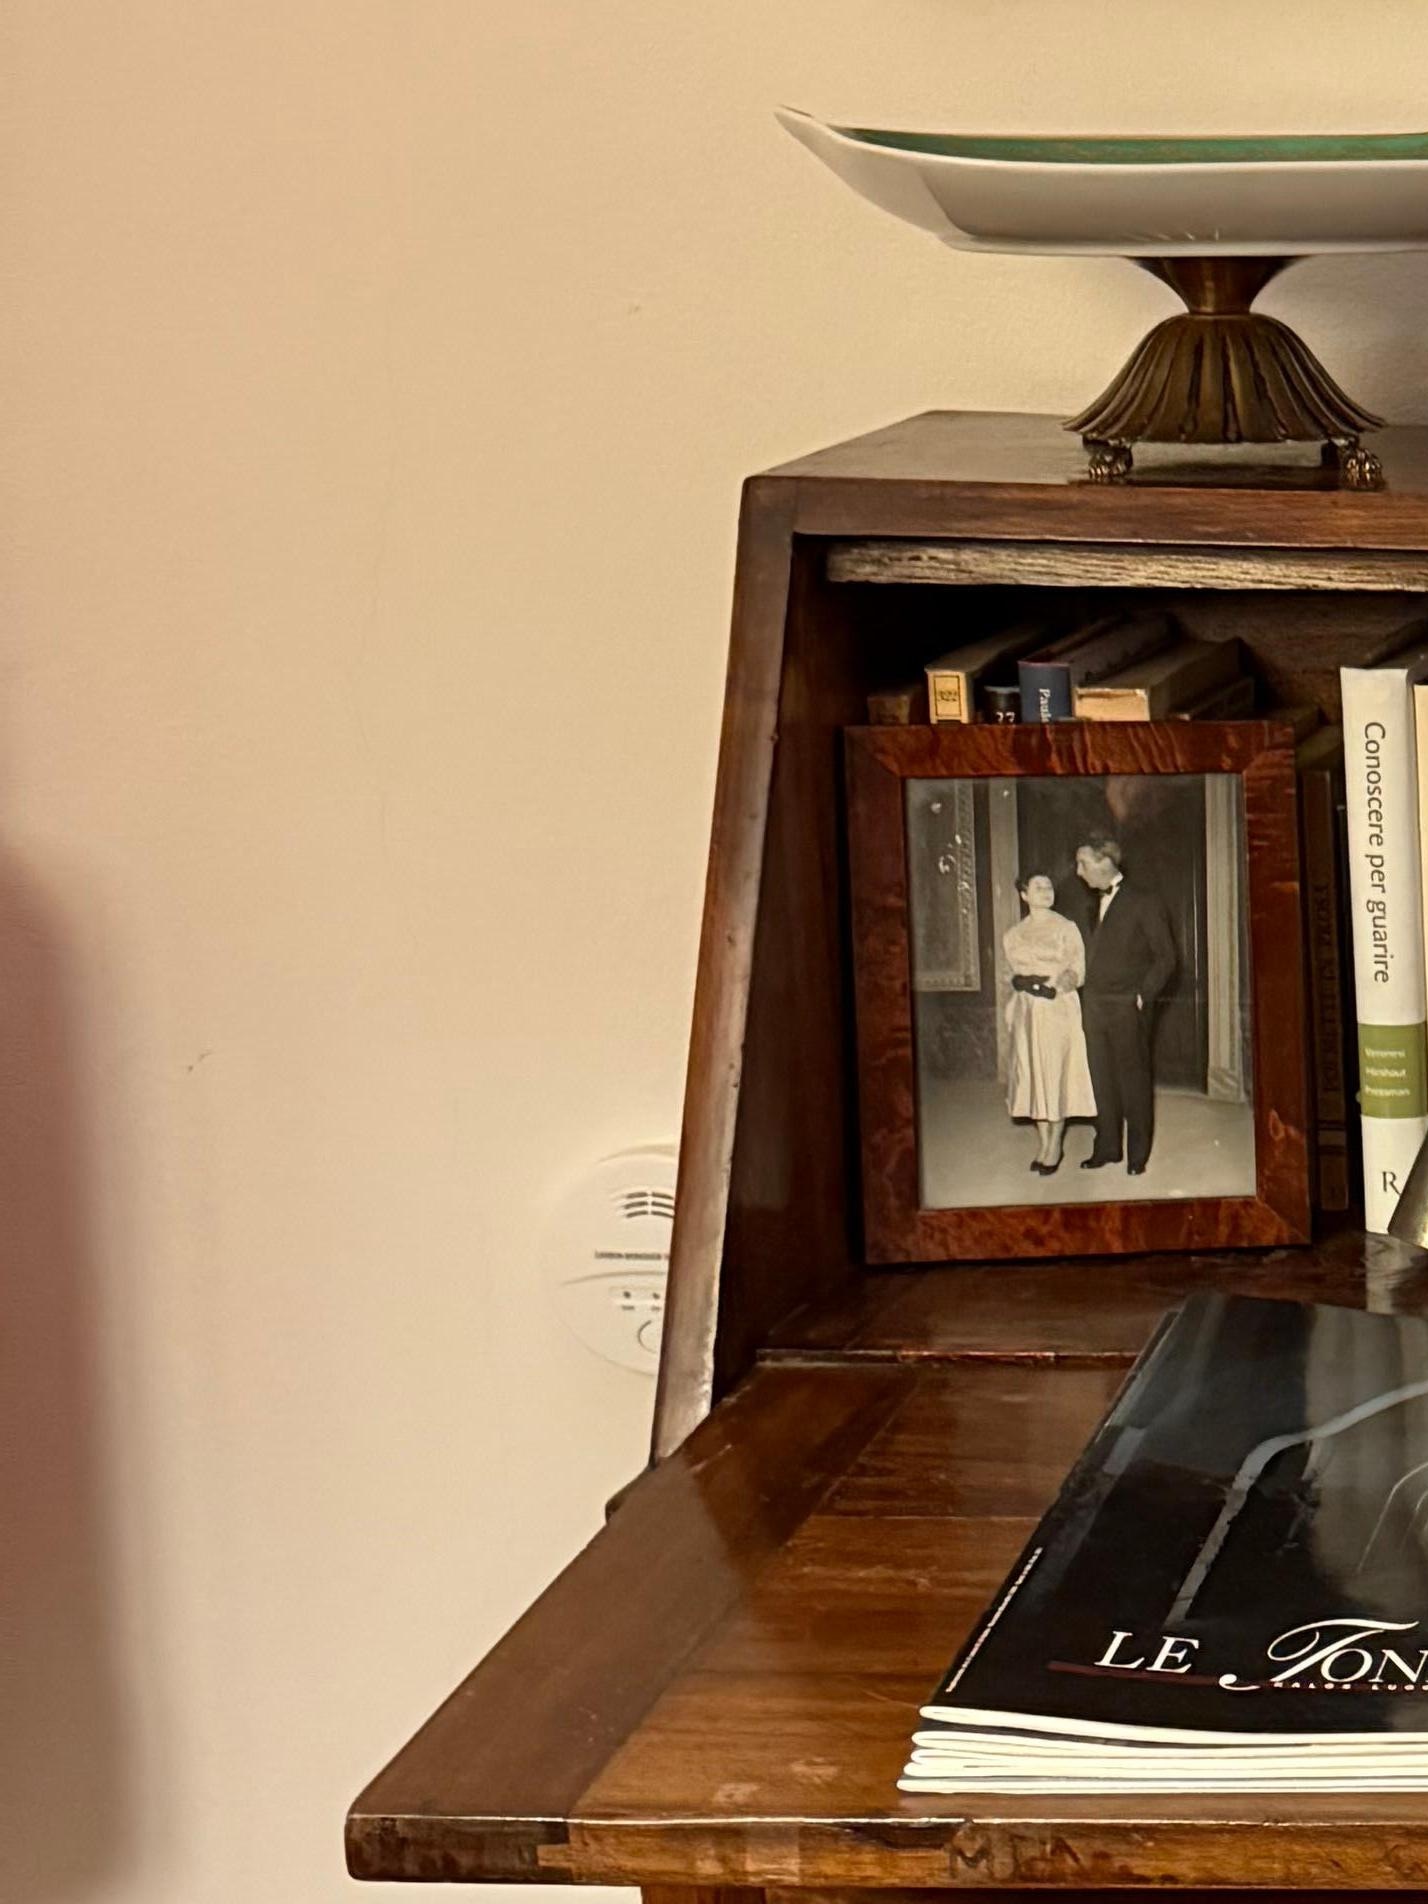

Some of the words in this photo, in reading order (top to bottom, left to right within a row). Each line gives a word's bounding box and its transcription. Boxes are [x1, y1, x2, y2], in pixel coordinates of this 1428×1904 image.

[1364, 721, 1387, 848] Conoscere
[1365, 857, 1384, 891] per
[1365, 897, 1392, 984] guarire
[1093, 1630, 1200, 1674] LE
